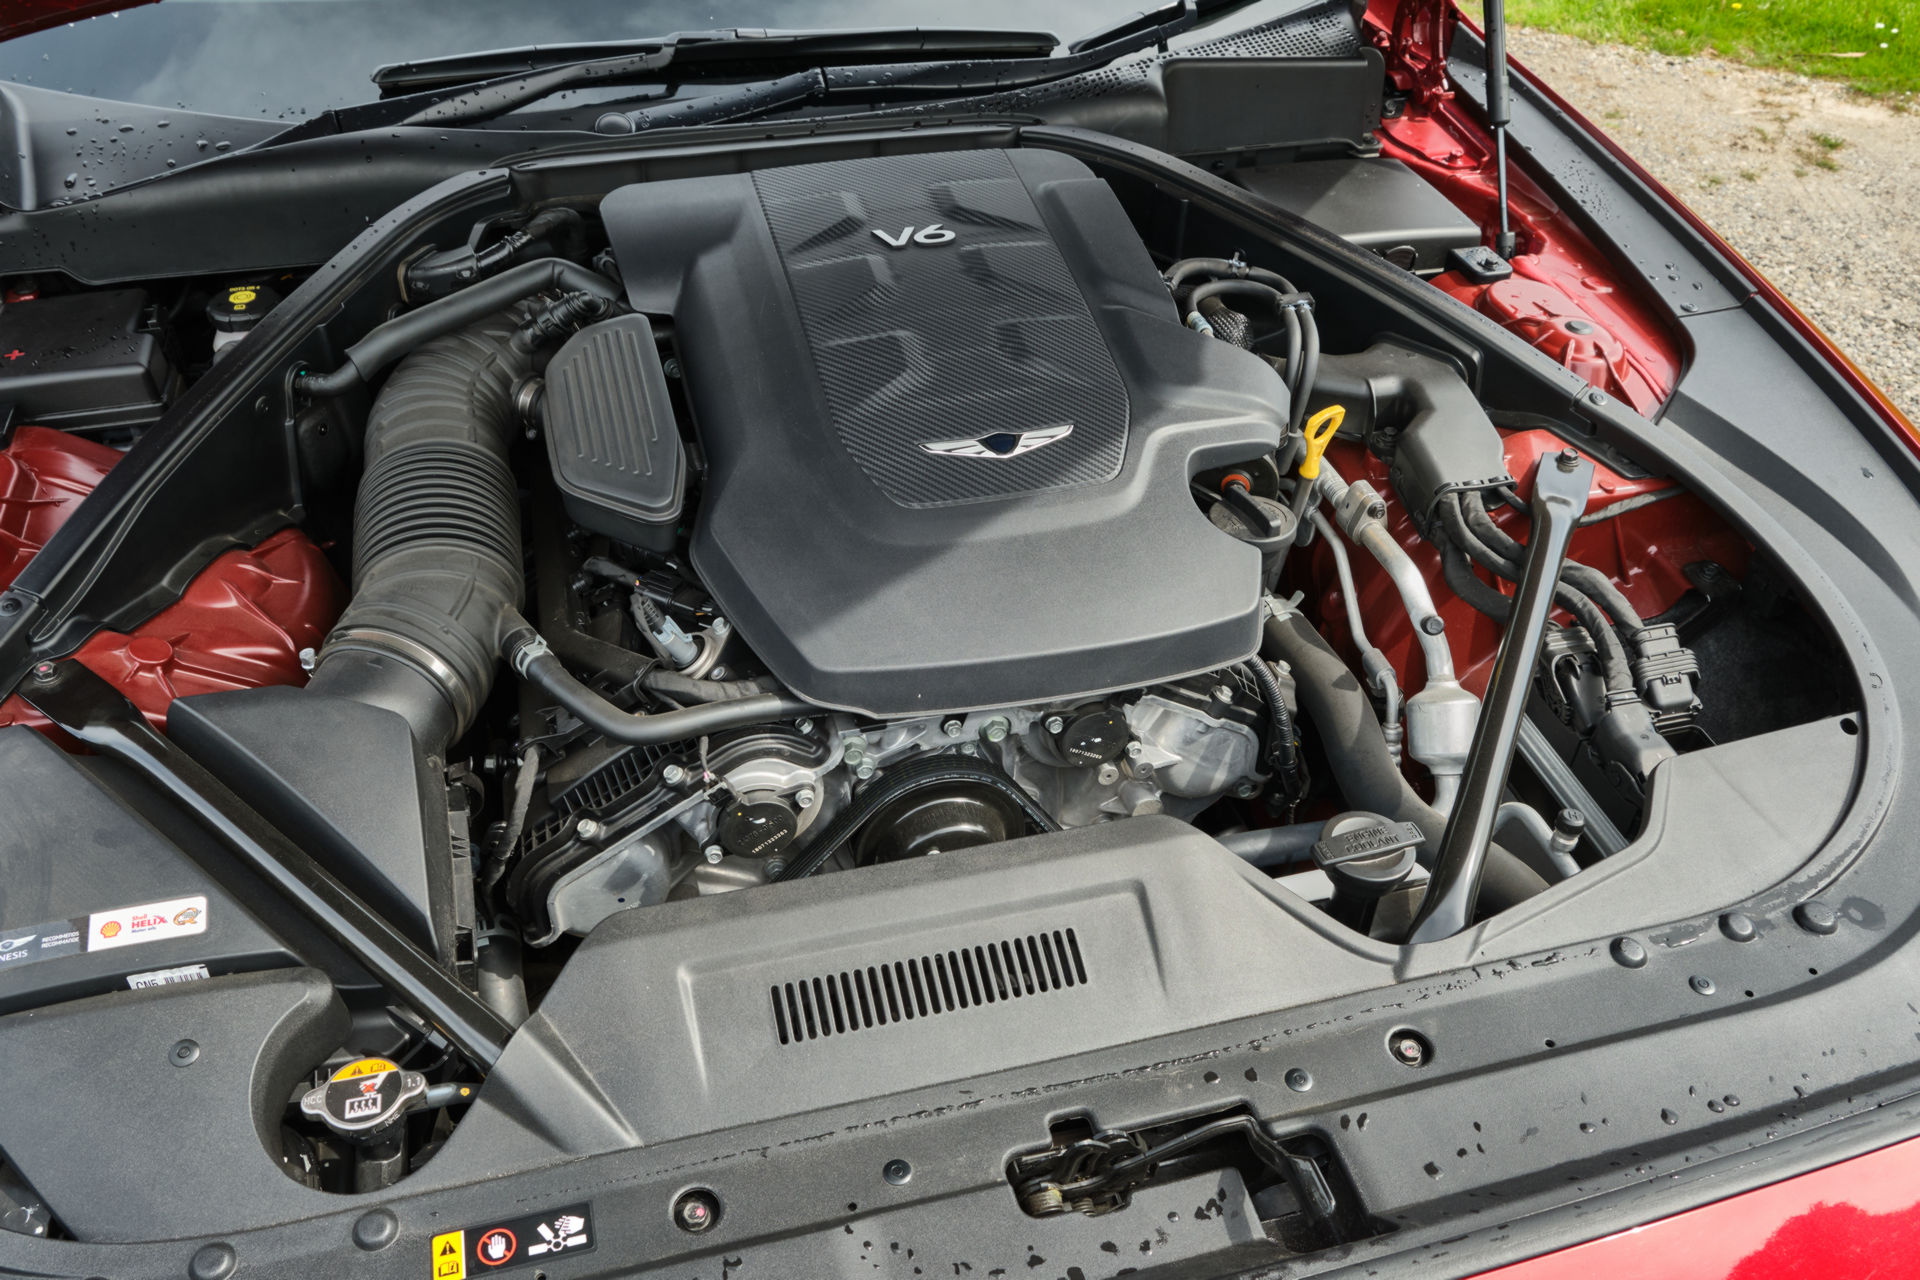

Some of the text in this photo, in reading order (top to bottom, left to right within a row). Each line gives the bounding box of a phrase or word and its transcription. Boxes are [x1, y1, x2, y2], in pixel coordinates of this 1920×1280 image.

[871, 223, 956, 247] V6
[1344, 825, 1389, 843] ENGINE
[1344, 833, 1401, 853] COOLANT
[131, 915, 168, 929] HELIX
